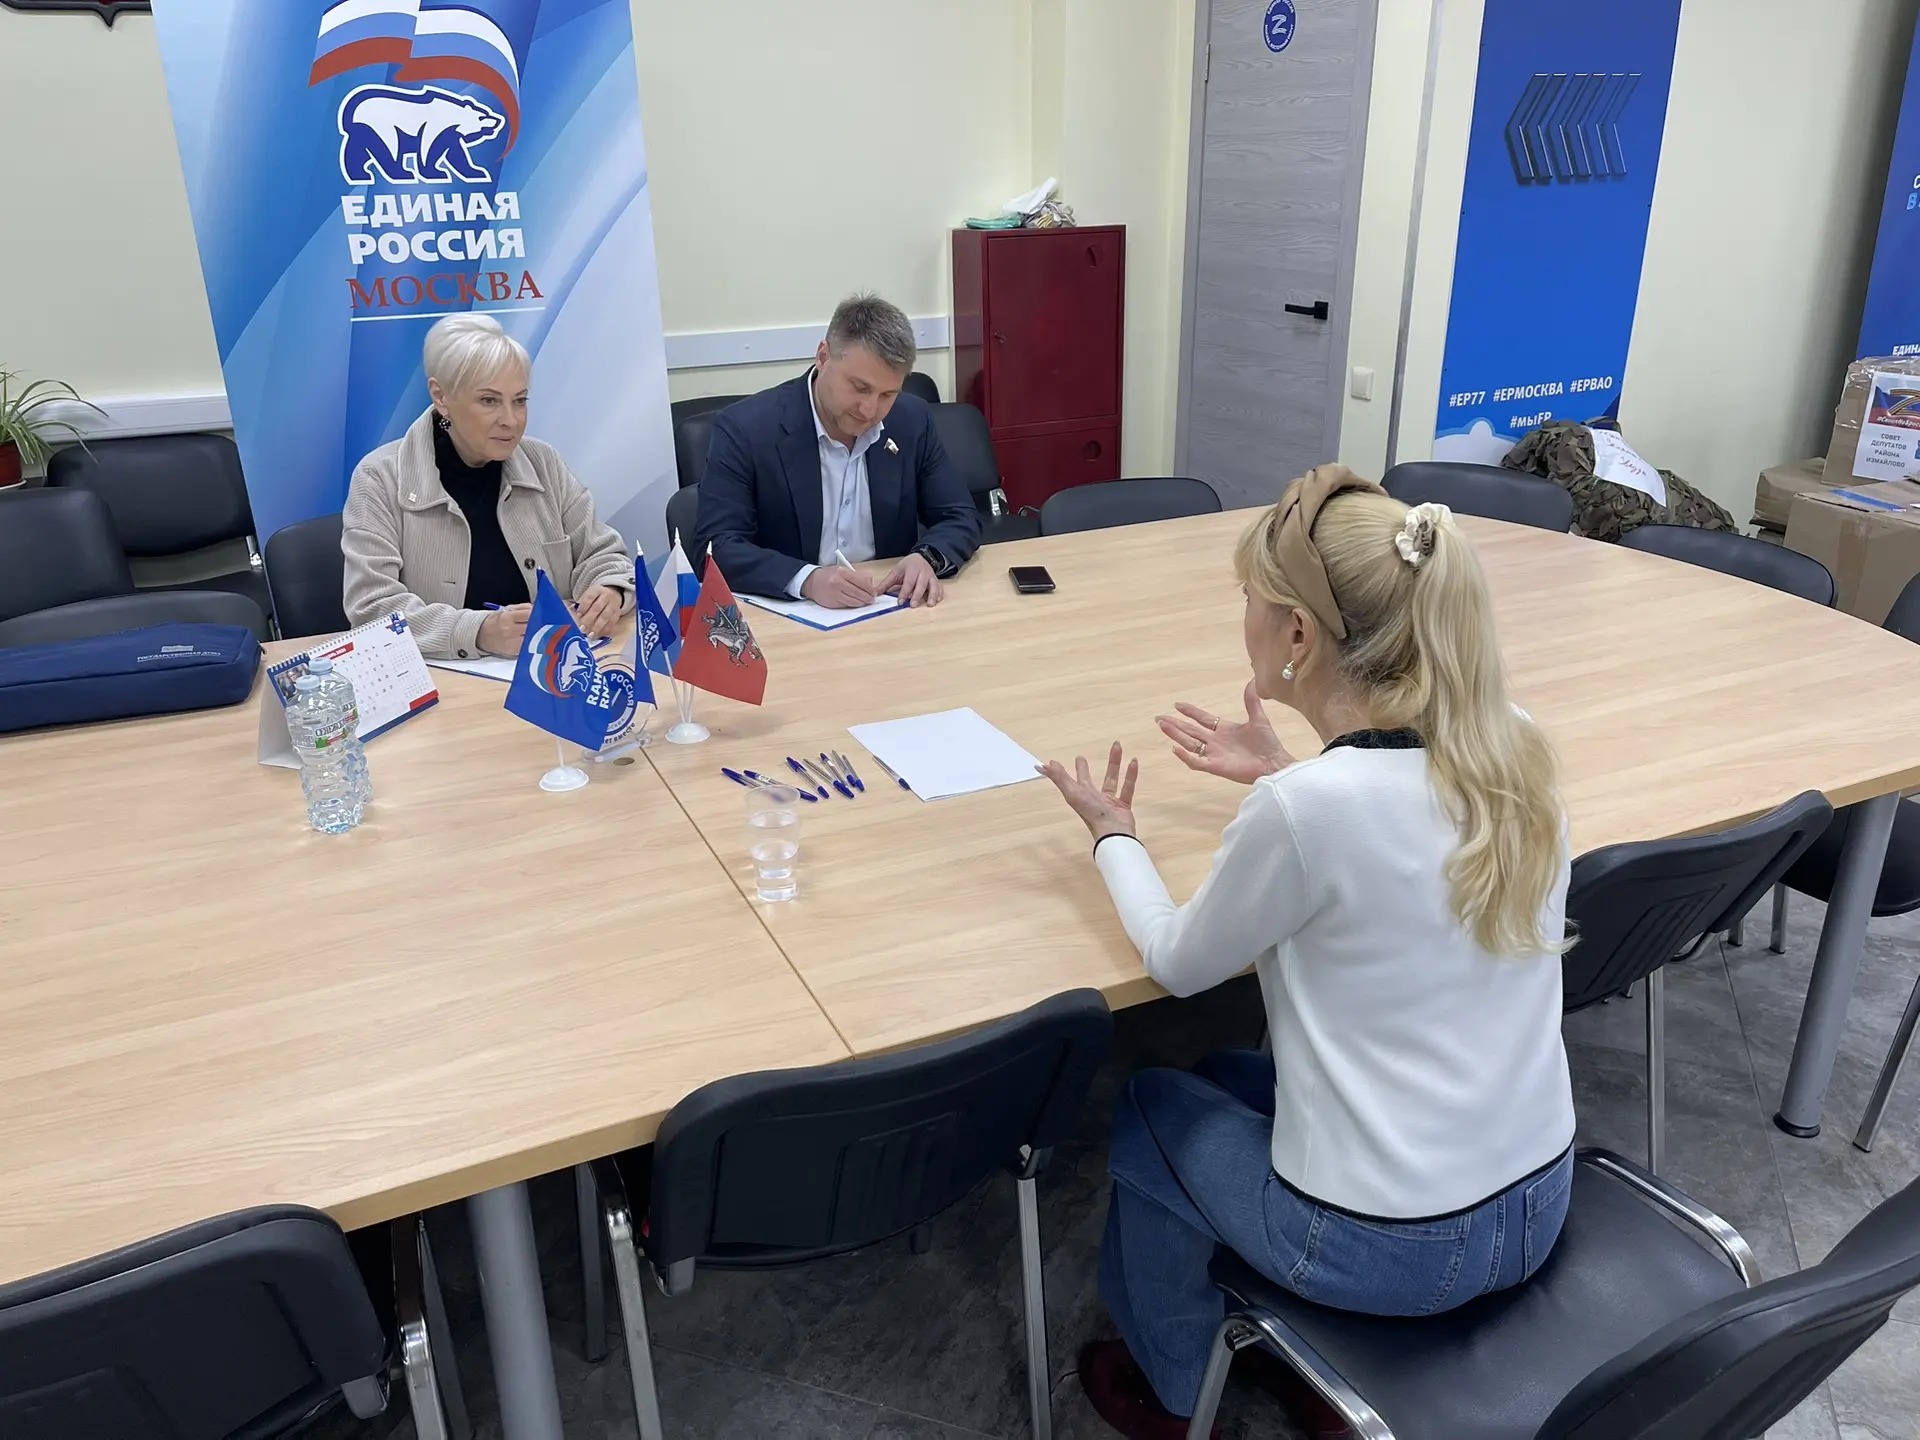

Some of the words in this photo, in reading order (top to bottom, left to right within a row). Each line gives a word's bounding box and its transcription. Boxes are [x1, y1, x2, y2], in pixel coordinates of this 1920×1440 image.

[341, 191, 521, 228] ЕДИНАЯ
[347, 228, 526, 265] РОССИЯ
[345, 270, 544, 309] МОСКВА
[1449, 391, 1486, 407] #ЕР77
[1493, 381, 1563, 402] #ЕРМОСКВА
[1570, 376, 1613, 393] #ЕРВАО
[1870, 440, 1907, 450] ДЕПУТАТОВ
[1880, 432, 1901, 441] СОВЕТ
[1866, 457, 1906, 468] ИЗМАЙЛОВО
[1874, 449, 1900, 458] РАЙОНА
[610, 673, 635, 707] РОССИЯ
